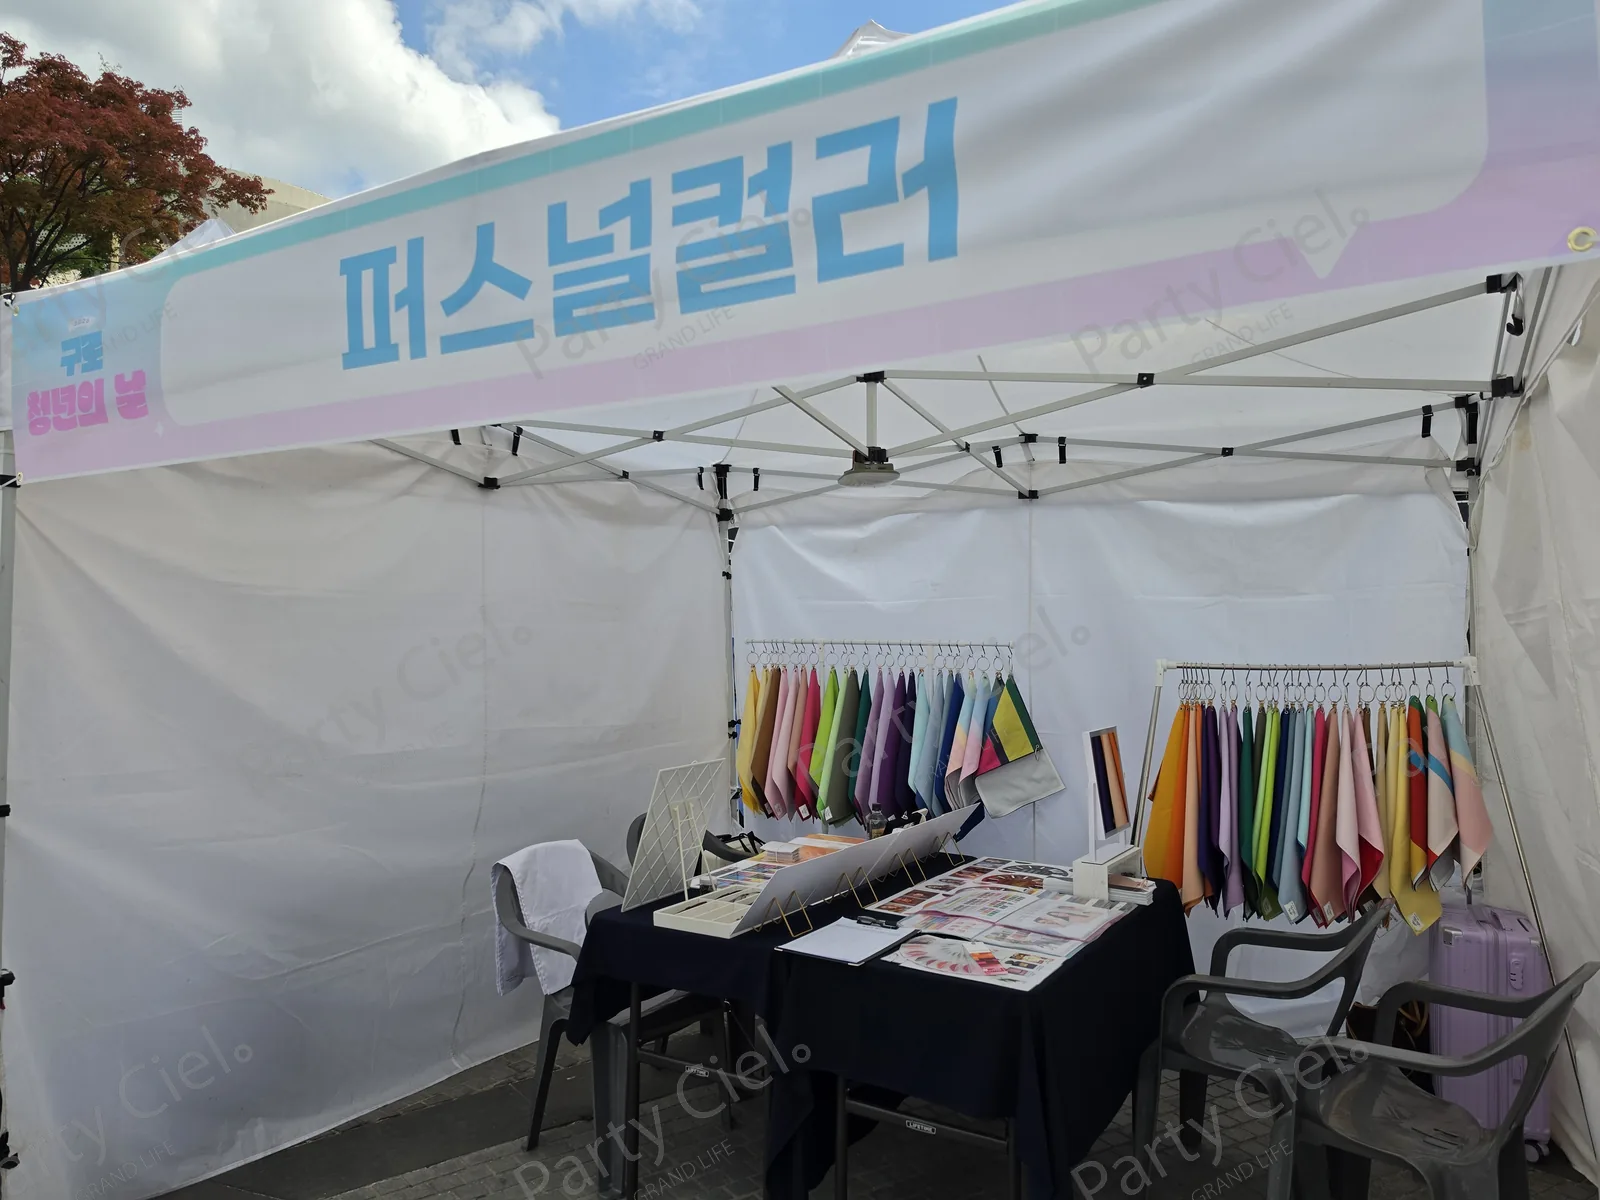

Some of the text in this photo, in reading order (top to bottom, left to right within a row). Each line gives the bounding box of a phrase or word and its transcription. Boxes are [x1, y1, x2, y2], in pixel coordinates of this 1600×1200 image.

[340, 97, 958, 370] 퍼스널컬러
[60, 330, 103, 377] 구로
[27, 369, 149, 436] 청년의 날
